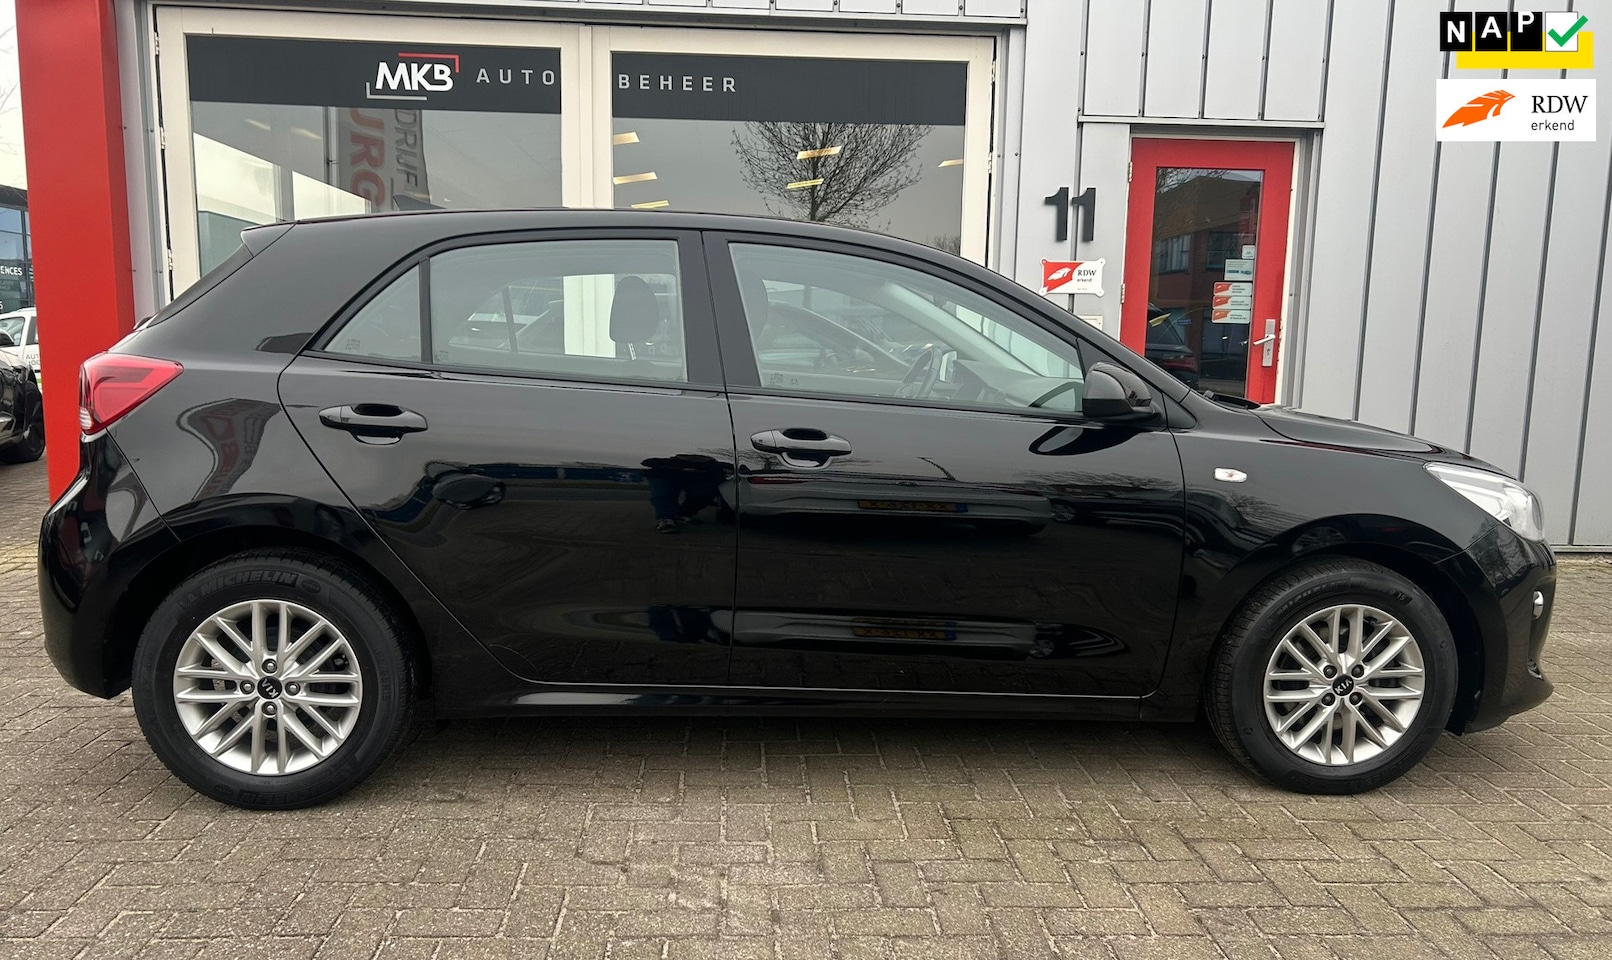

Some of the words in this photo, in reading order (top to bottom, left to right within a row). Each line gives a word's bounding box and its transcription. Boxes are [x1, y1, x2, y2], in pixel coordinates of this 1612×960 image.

[375, 61, 454, 92] MKB
[476, 68, 556, 86] AUTO
[618, 73, 737, 93] BEHEER
[1044, 186, 1097, 242] 11
[0, 265, 23, 276] ENCES
[1077, 269, 1097, 277] RDW
[201, 571, 299, 596] MICHELIN
[261, 678, 279, 698] KIA
[1334, 679, 1352, 694] KIA
